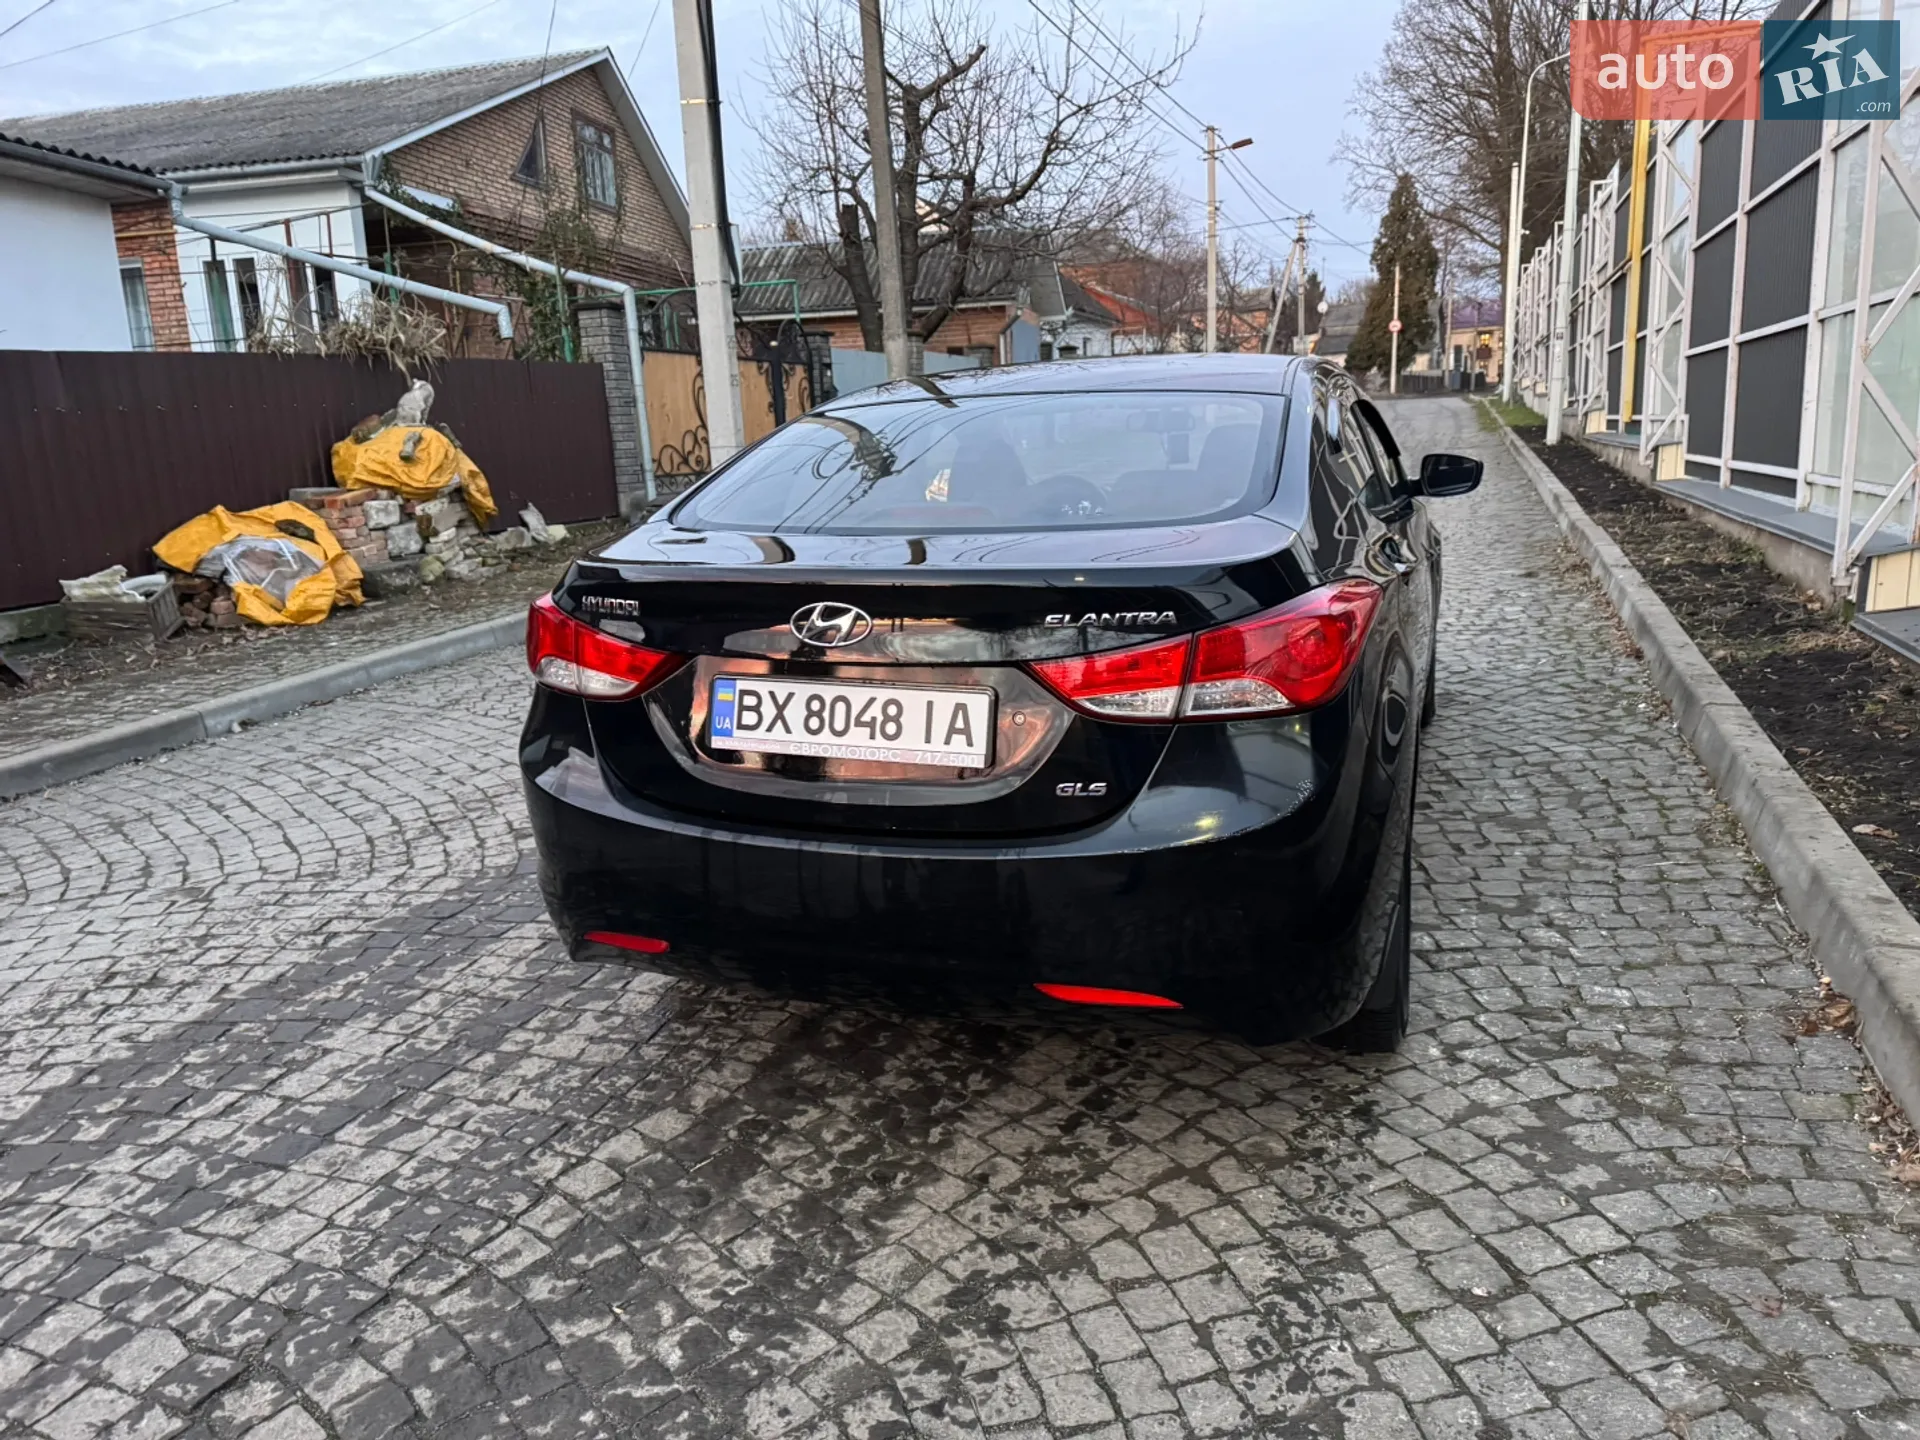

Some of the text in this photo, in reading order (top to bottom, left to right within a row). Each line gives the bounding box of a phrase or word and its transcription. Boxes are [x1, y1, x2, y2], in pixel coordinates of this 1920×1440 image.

[582, 595, 640, 617] HYUNDAI
[1043, 611, 1178, 628] ELANTRA
[715, 715, 732, 730] UA
[736, 689, 975, 748] BX 8048 IA
[914, 752, 978, 767] 717-500
[1055, 782, 1108, 797] GLS
